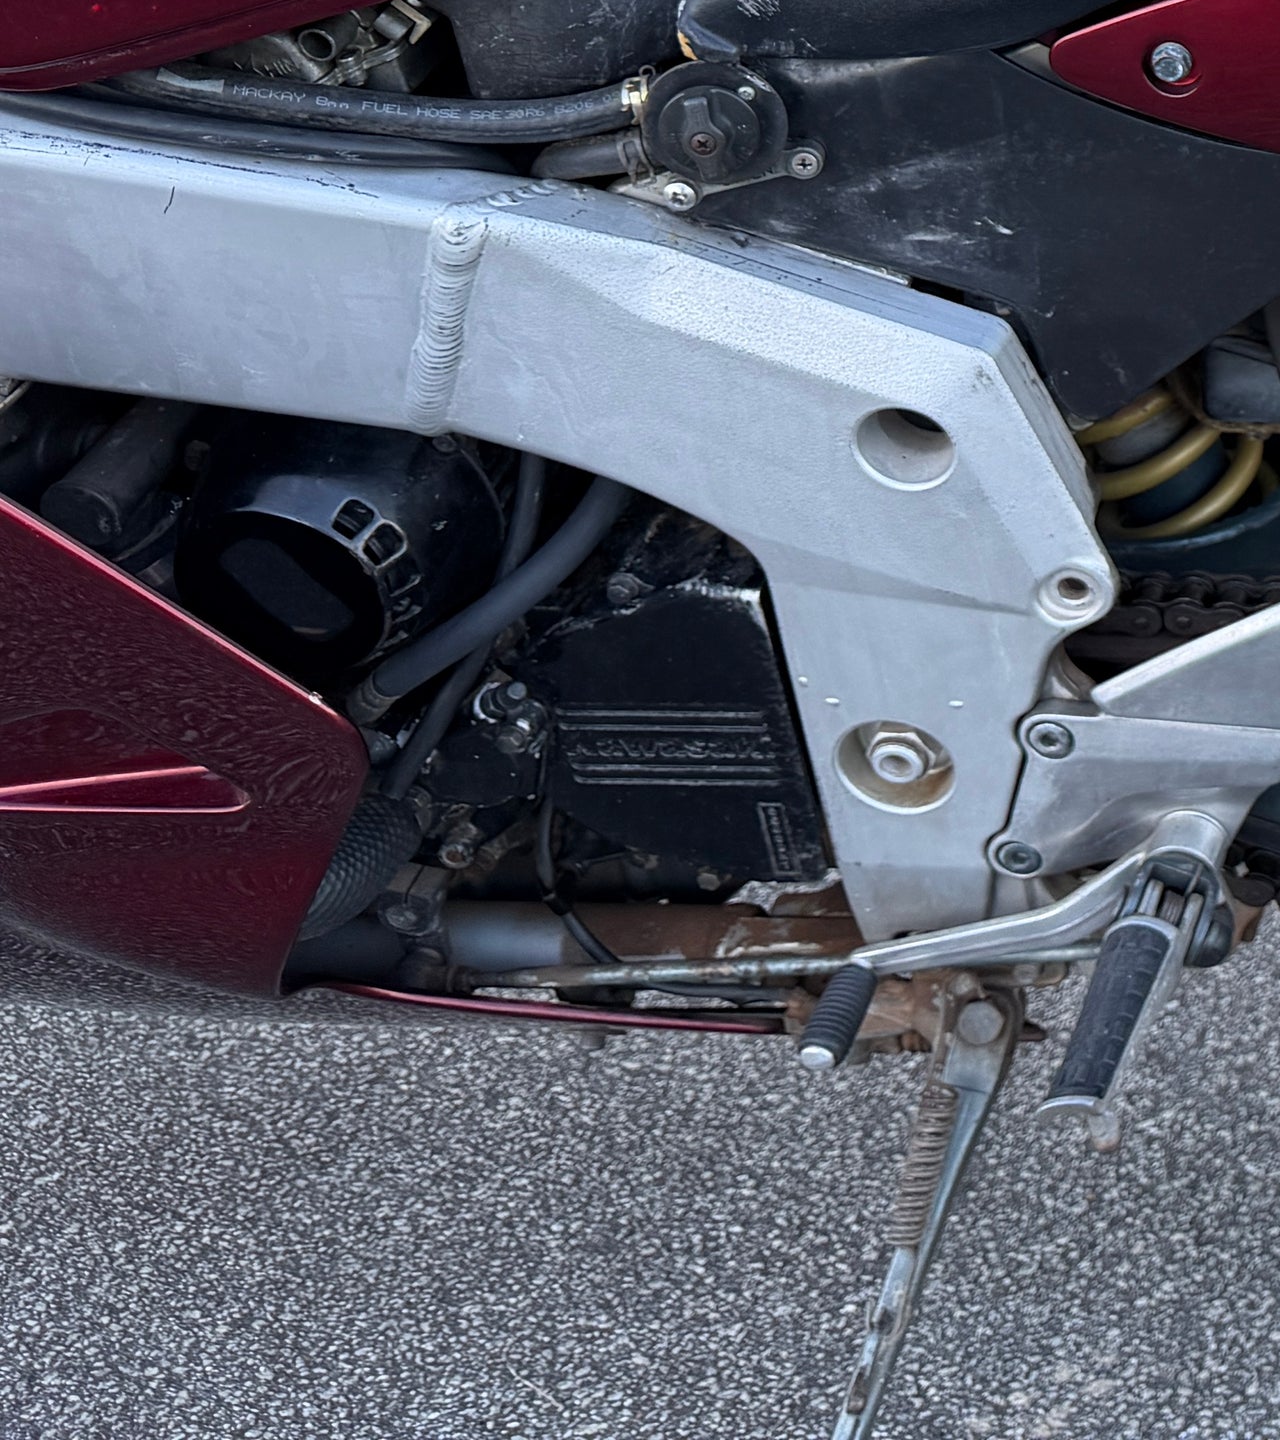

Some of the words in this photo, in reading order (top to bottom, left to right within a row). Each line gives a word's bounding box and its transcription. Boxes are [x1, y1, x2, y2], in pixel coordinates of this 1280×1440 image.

[233, 85, 306, 103] MACKAY
[361, 101, 408, 116] FUEL
[416, 105, 461, 119] HOSE
